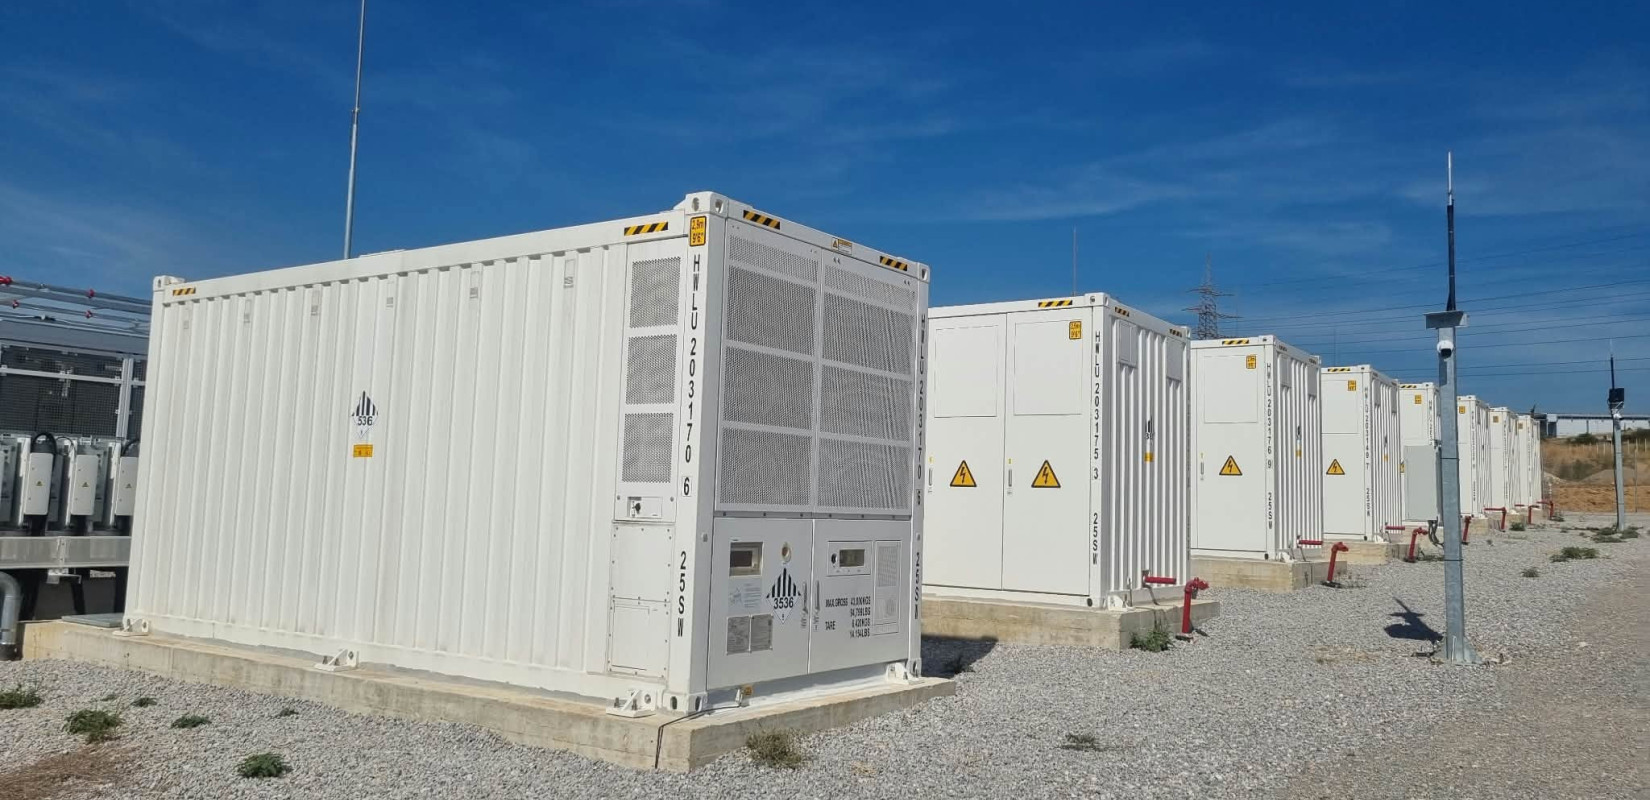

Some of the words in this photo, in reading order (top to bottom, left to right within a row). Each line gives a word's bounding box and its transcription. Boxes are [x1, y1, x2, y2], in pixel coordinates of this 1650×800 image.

[691, 254, 701, 330] HWLU
[685, 337, 697, 464] 203170
[683, 477, 690, 496] 6
[1093, 467, 1099, 480] 3
[677, 550, 687, 637] 25SW
[773, 596, 794, 610] 3536
